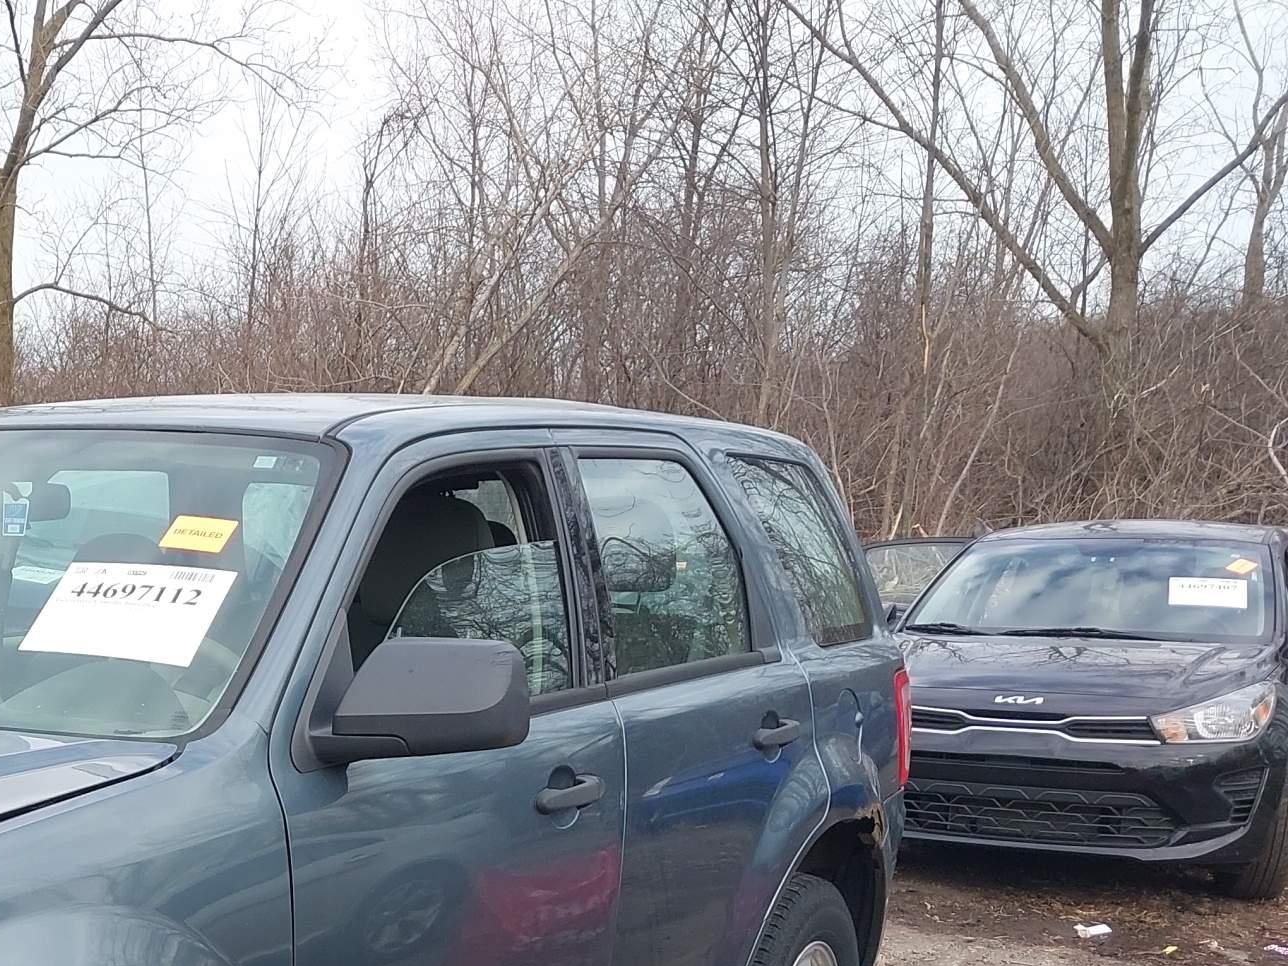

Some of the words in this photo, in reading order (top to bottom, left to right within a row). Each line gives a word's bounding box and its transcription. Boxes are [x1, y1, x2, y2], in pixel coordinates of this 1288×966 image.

[172, 528, 224, 539] DETAILED
[70, 581, 203, 606] 44697112
[994, 695, 1044, 705] KIA
